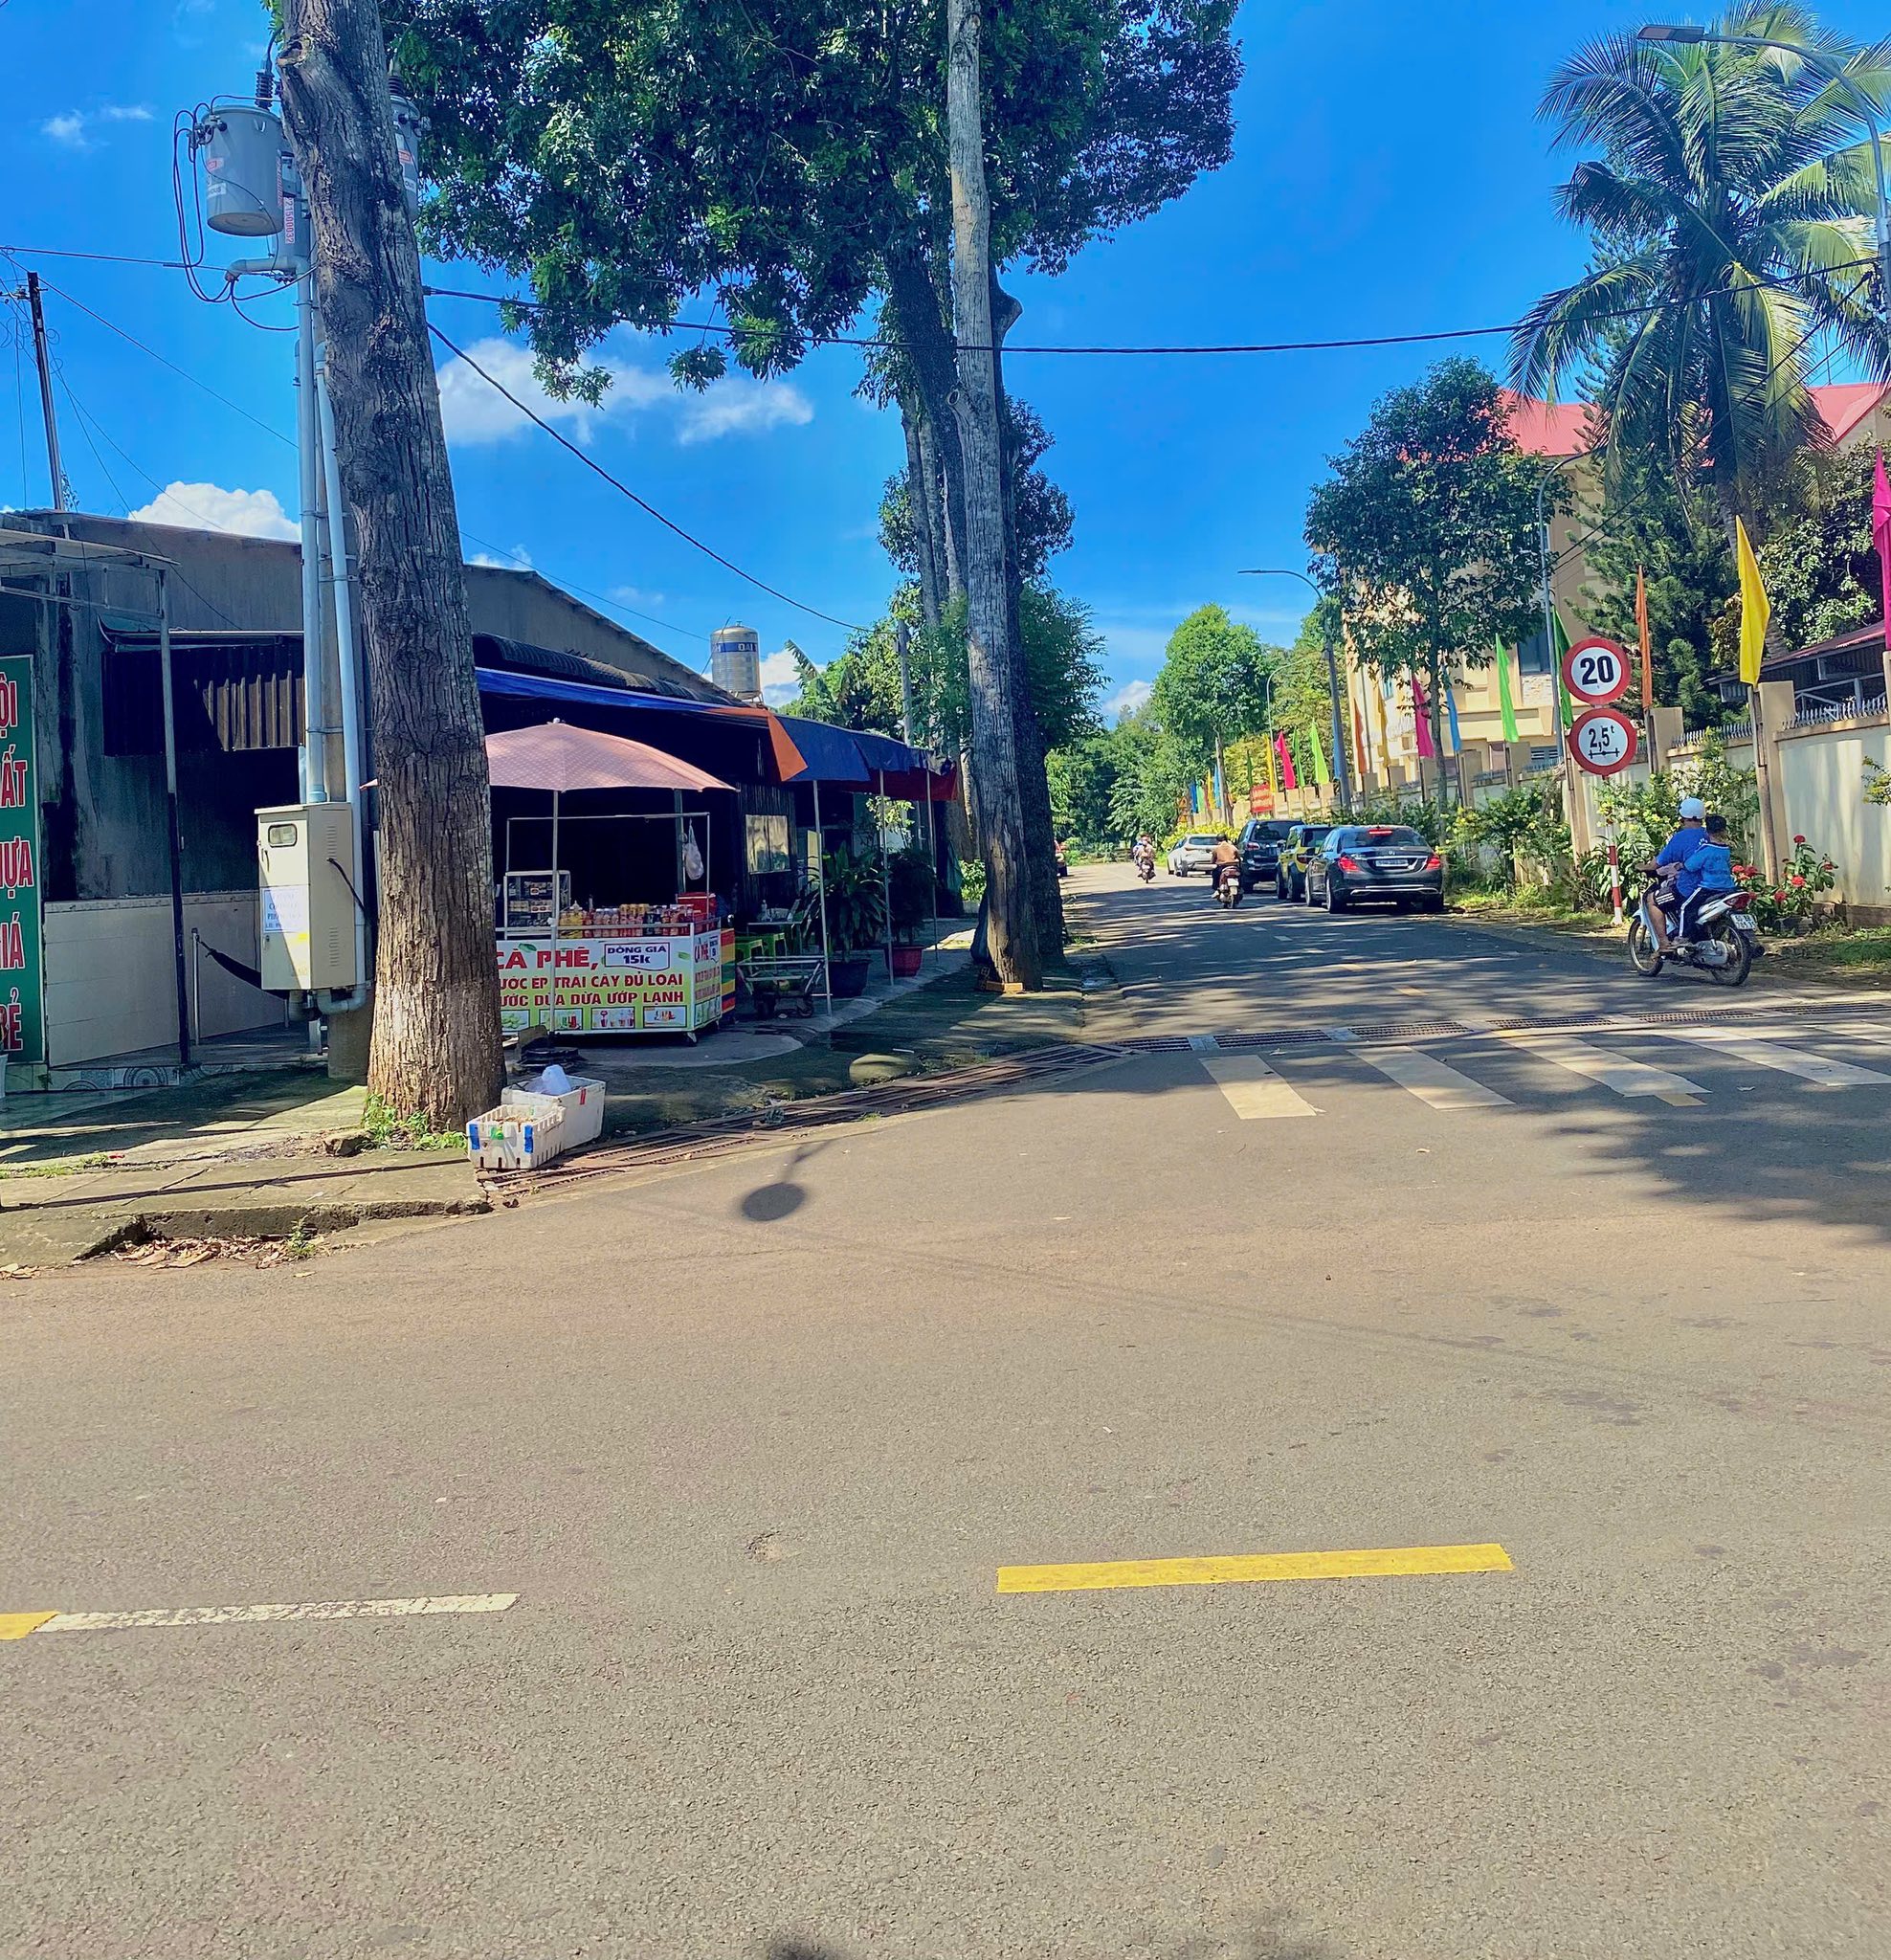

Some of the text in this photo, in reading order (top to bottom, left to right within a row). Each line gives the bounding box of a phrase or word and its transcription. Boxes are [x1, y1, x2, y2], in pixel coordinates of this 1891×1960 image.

[1580, 655, 1614, 686] 20
[0, 744, 28, 809] ẤT
[0, 835, 34, 900] ỰA
[0, 911, 26, 970] IÁ
[607, 990, 638, 1004] ƯỚP
[643, 991, 684, 1006] LẠNH
[625, 970, 644, 987] ĐỦ
[648, 973, 682, 988] LOẠI
